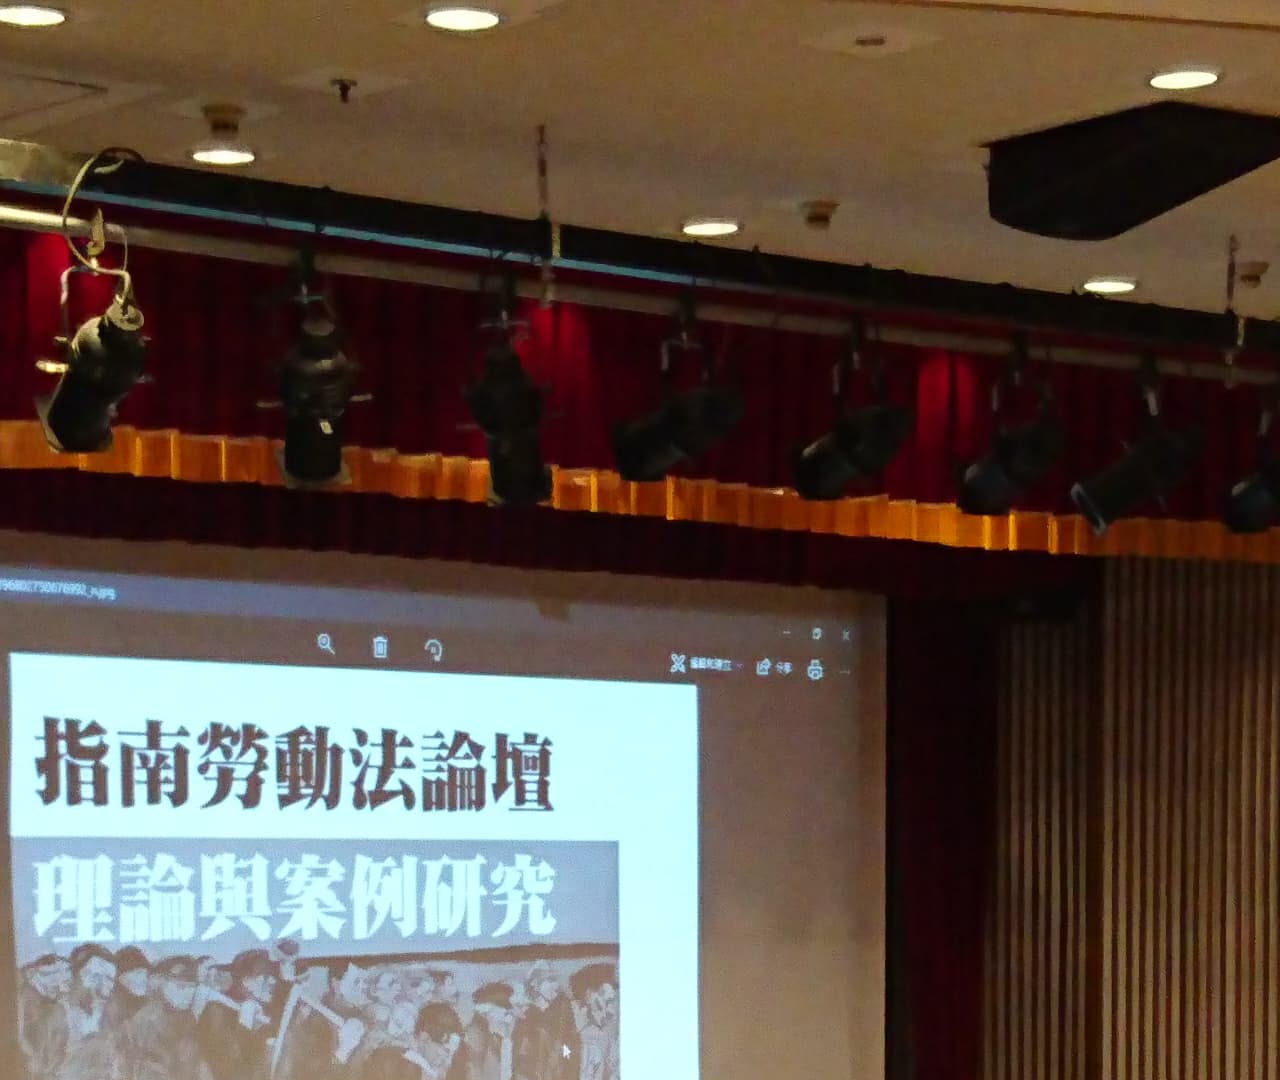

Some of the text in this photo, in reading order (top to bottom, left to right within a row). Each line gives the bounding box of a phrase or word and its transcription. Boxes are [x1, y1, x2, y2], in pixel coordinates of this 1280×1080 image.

[35, 716, 554, 812] 指南勞動法論壇
[32, 851, 556, 943] 理論與案例研究
